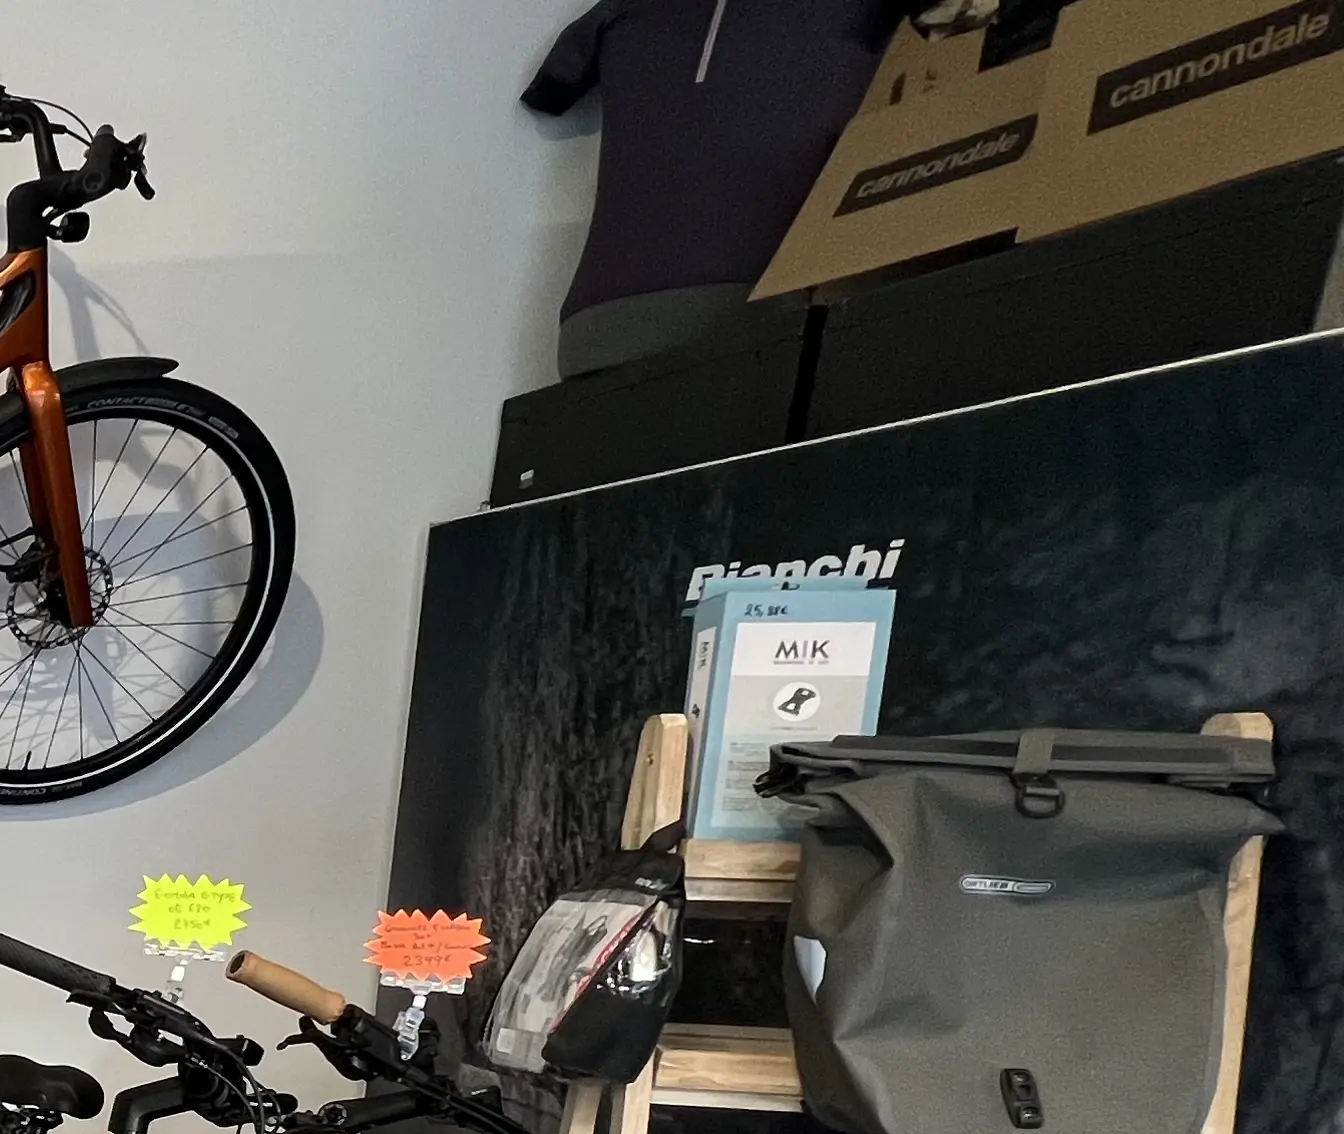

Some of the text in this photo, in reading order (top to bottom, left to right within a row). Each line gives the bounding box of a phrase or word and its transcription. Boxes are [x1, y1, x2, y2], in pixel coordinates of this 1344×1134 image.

[1112, 9, 1330, 109] cannondale
[855, 129, 1020, 198] cannondale
[775, 640, 830, 660] MIK
